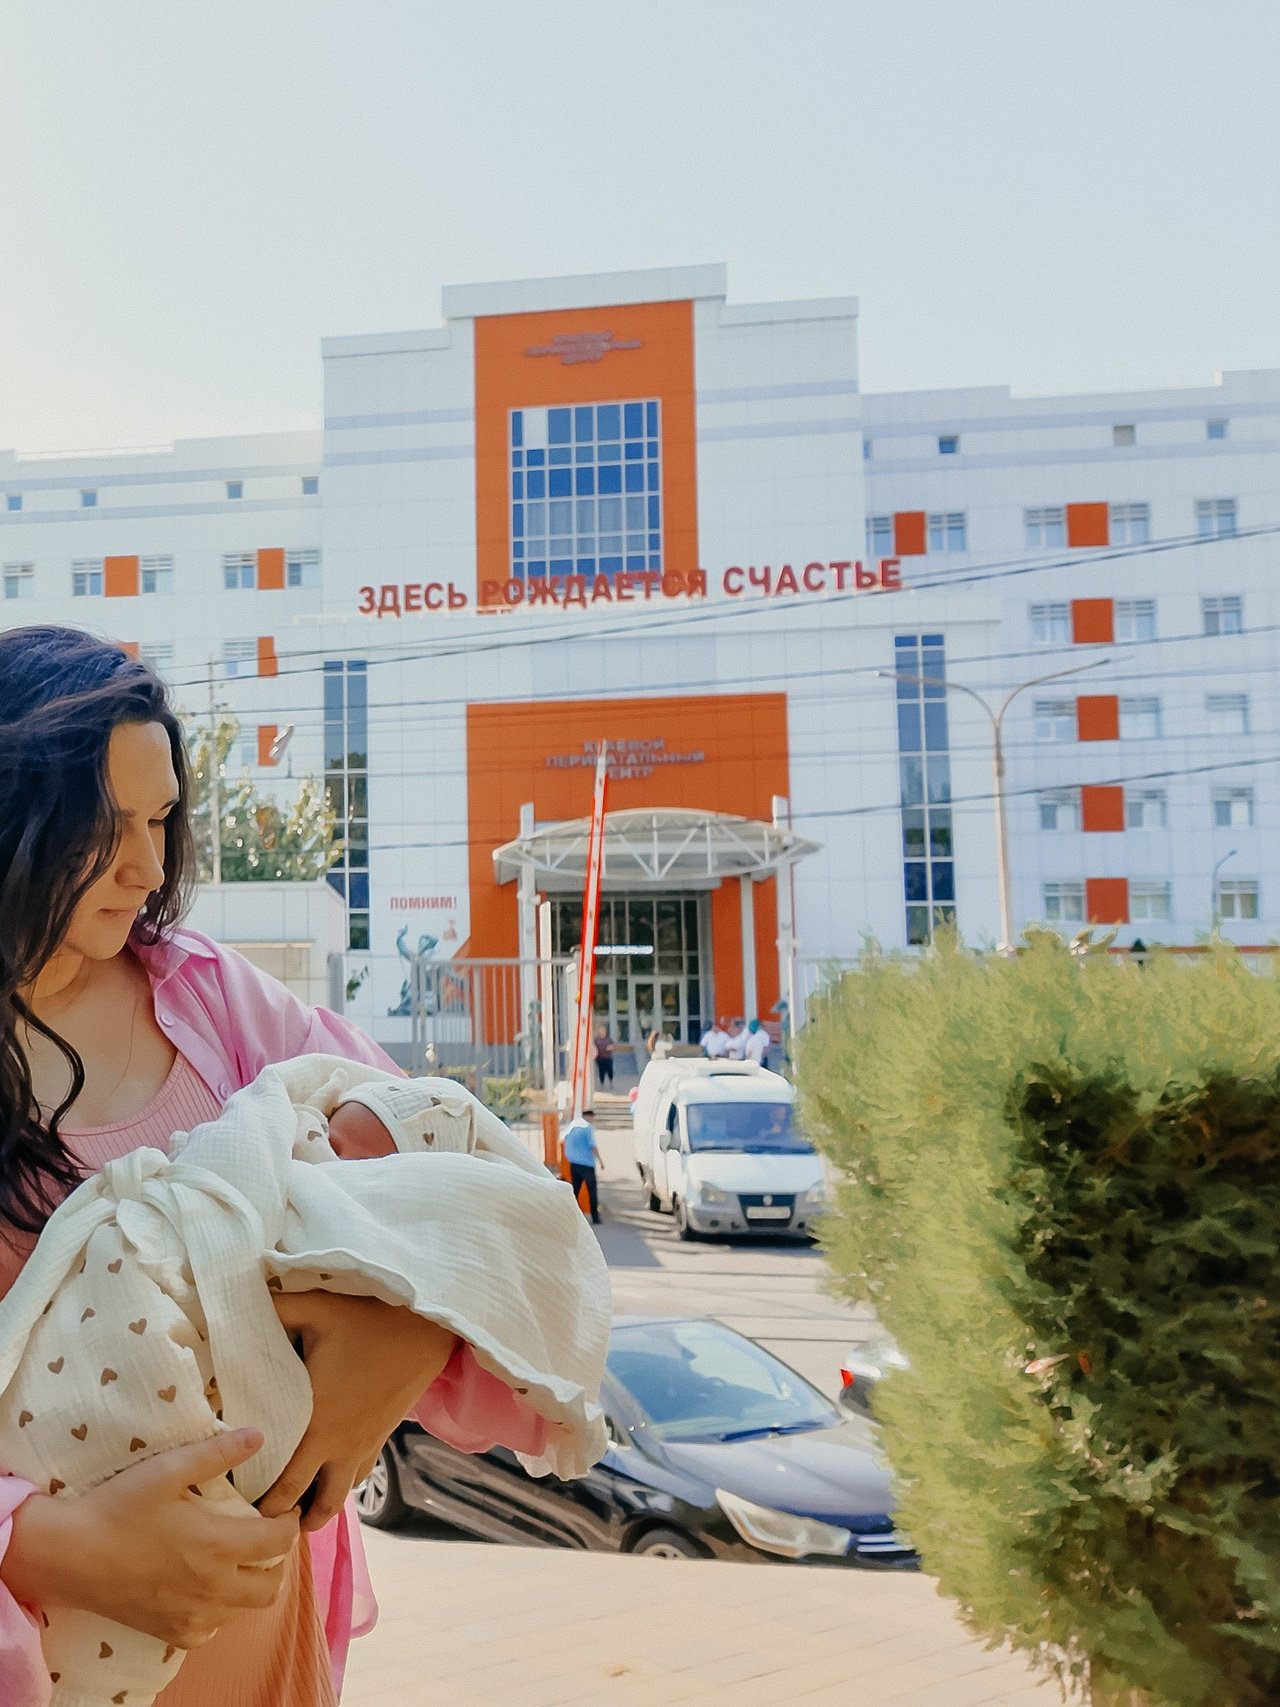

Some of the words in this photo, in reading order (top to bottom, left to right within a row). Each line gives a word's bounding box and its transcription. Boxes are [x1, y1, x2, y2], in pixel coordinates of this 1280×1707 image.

[358, 582, 468, 618] ЗДЕСЬ
[482, 569, 707, 610] РОЖДАЕТСЯ
[723, 558, 902, 596] СЧАСТЬЕ
[605, 765, 654, 779] ЕНТР
[390, 896, 457, 911] ПОМНИМ!
